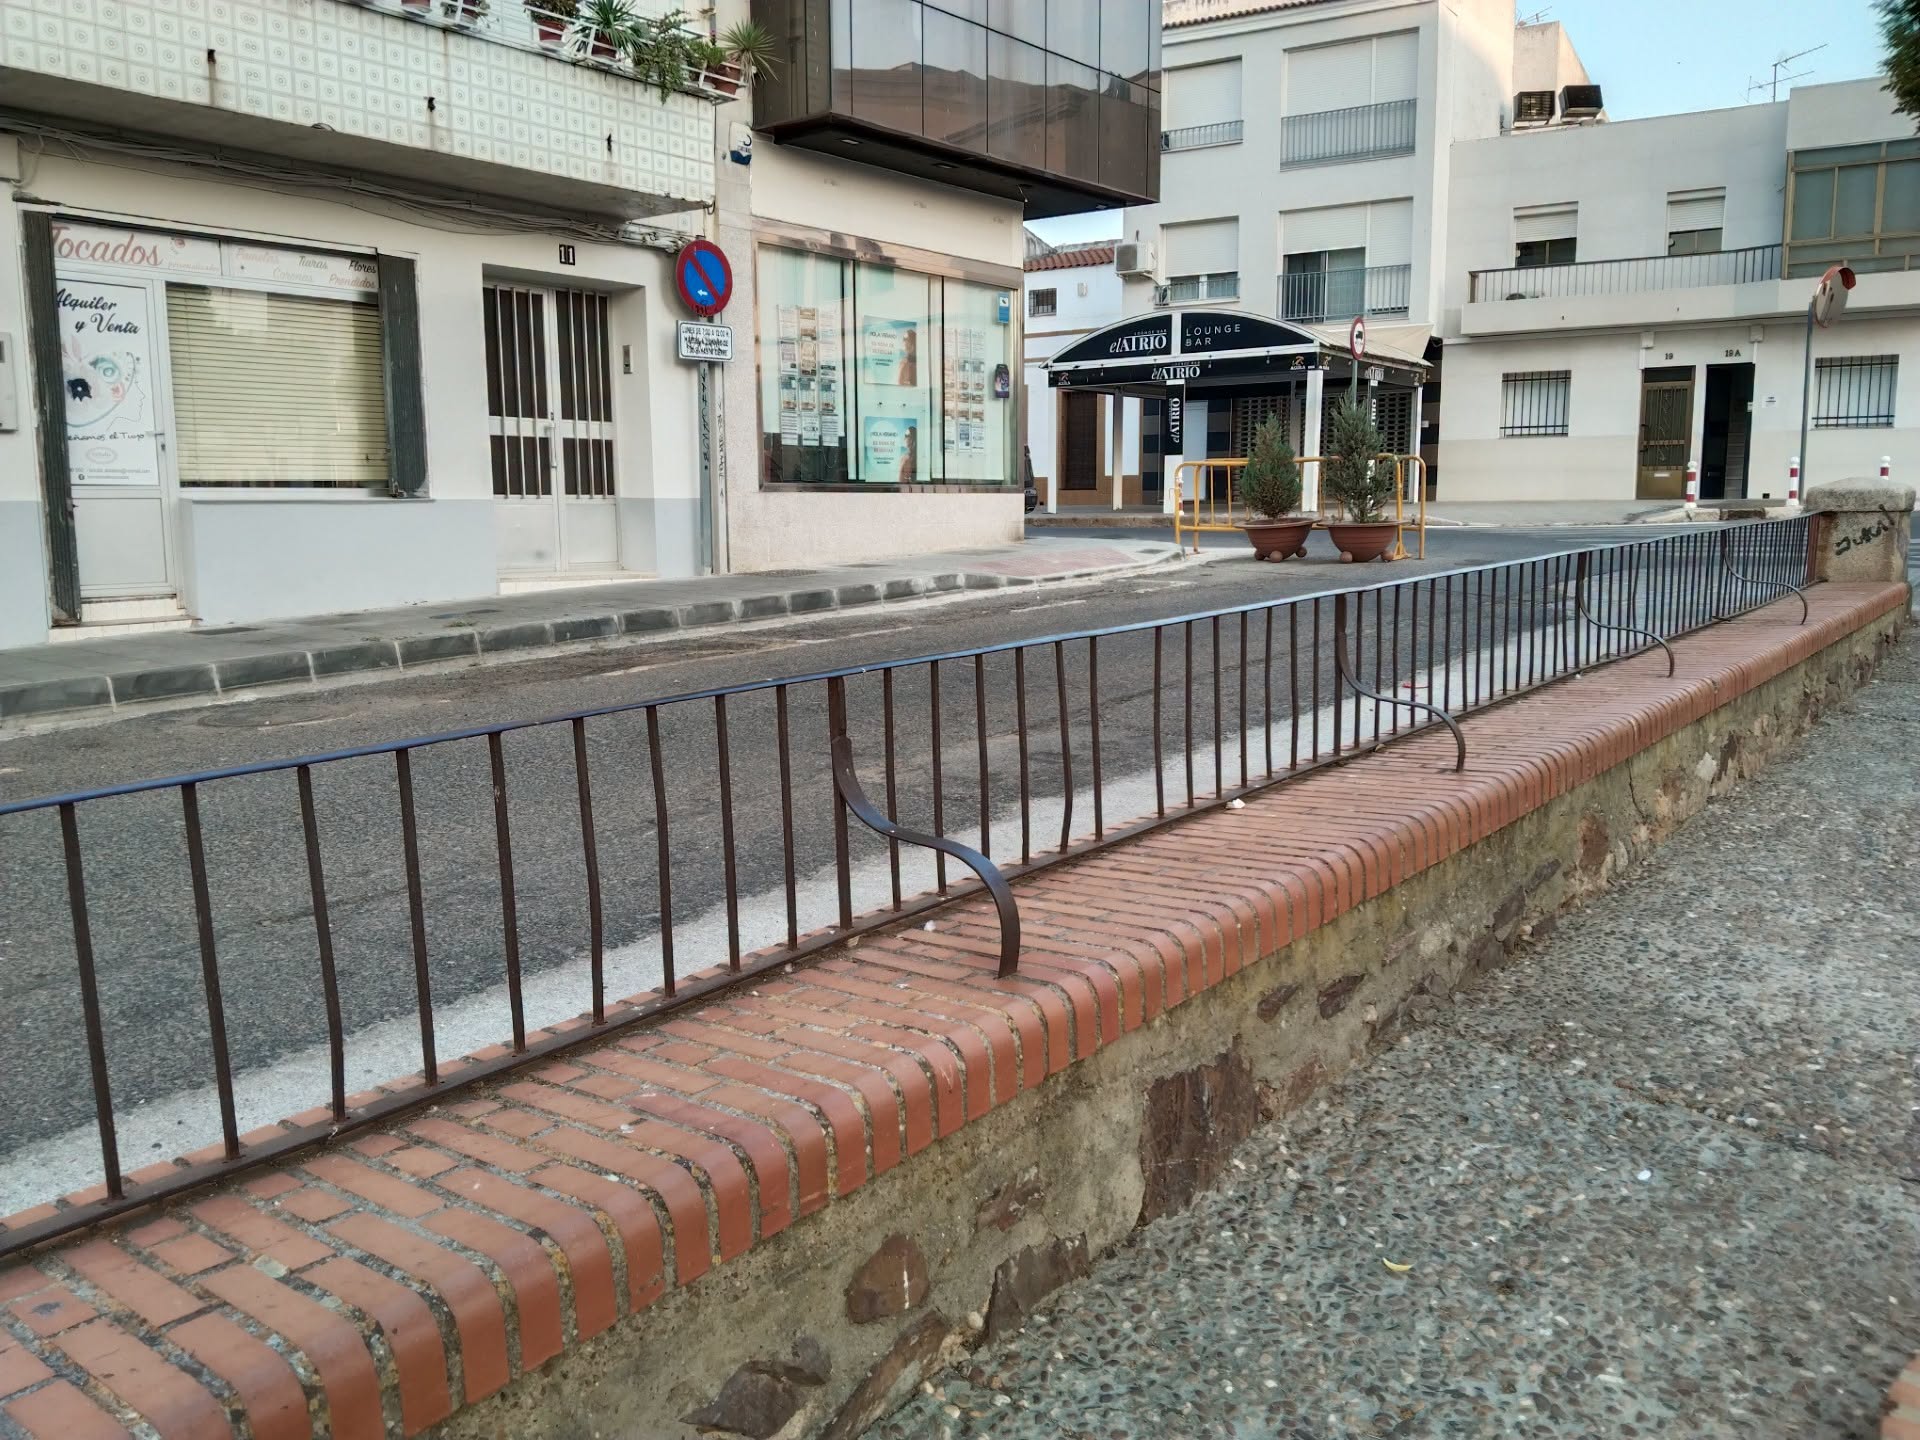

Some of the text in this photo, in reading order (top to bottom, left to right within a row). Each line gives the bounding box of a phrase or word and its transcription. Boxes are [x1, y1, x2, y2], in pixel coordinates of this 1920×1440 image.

[51, 226, 164, 267] Tocados
[559, 245, 575, 264] 11
[348, 259, 377, 274] Flores
[56, 288, 117, 311] Alquiler
[75, 313, 141, 335] y Venta
[1185, 324, 1241, 337] LOUNGE
[1185, 337, 1212, 347] BAR
[1664, 352, 1674, 360] 19
